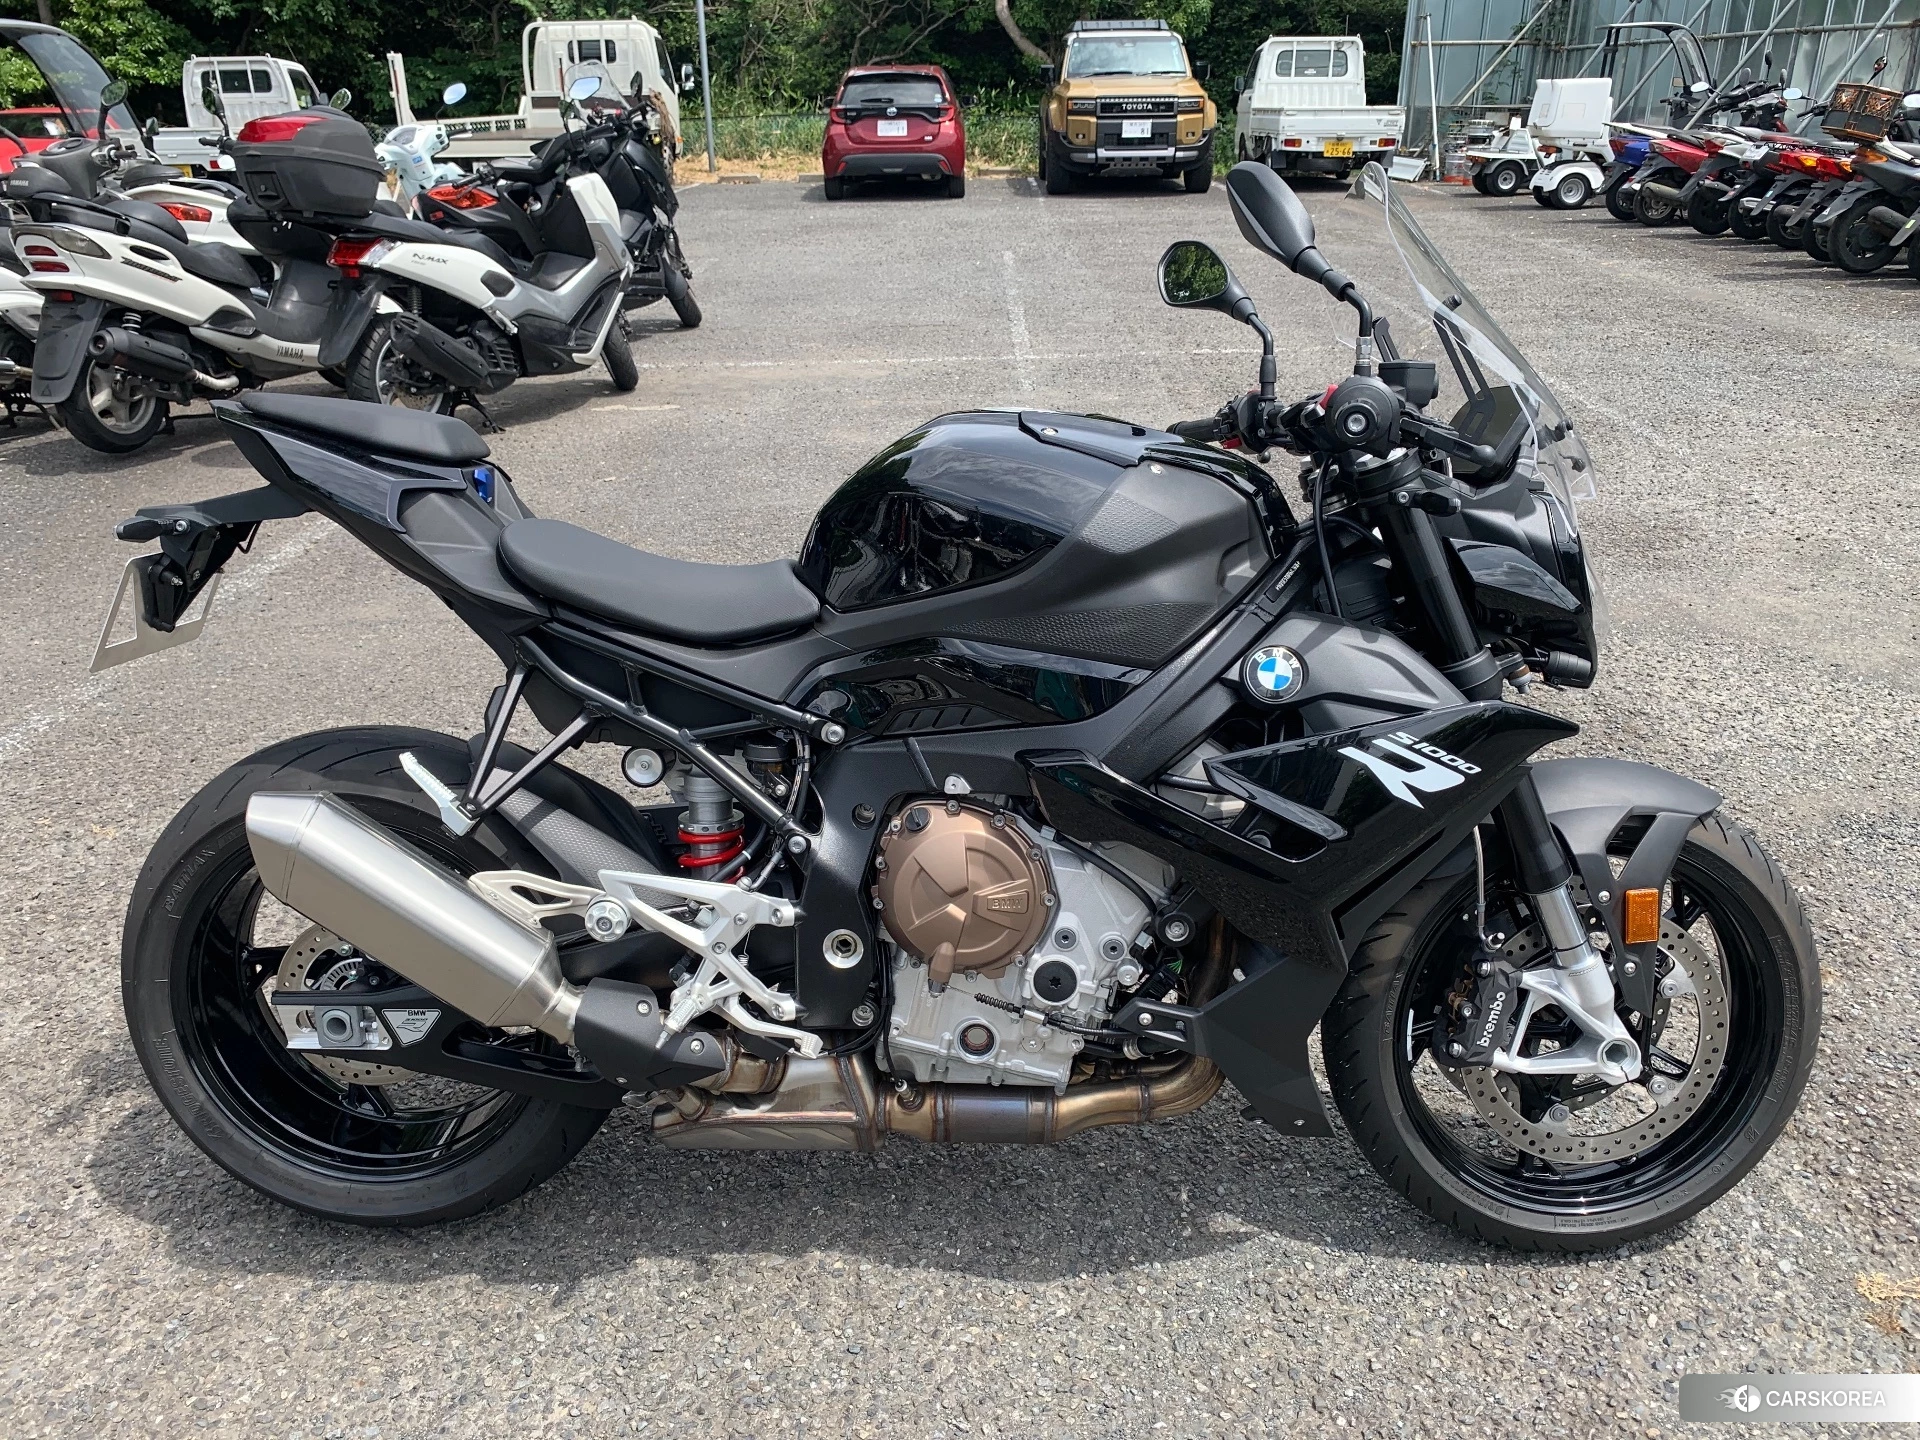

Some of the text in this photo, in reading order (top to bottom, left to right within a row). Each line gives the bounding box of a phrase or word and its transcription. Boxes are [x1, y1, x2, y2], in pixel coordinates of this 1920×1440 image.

[1140, 127, 1149, 135] 81
[277, 345, 304, 360] YAMAHA
[1254, 648, 1301, 669] BMW
[1337, 731, 1482, 810] S1000 R
[992, 898, 1023, 909] BMW
[407, 1009, 427, 1017] BMW
[1476, 991, 1506, 1048] brembo
